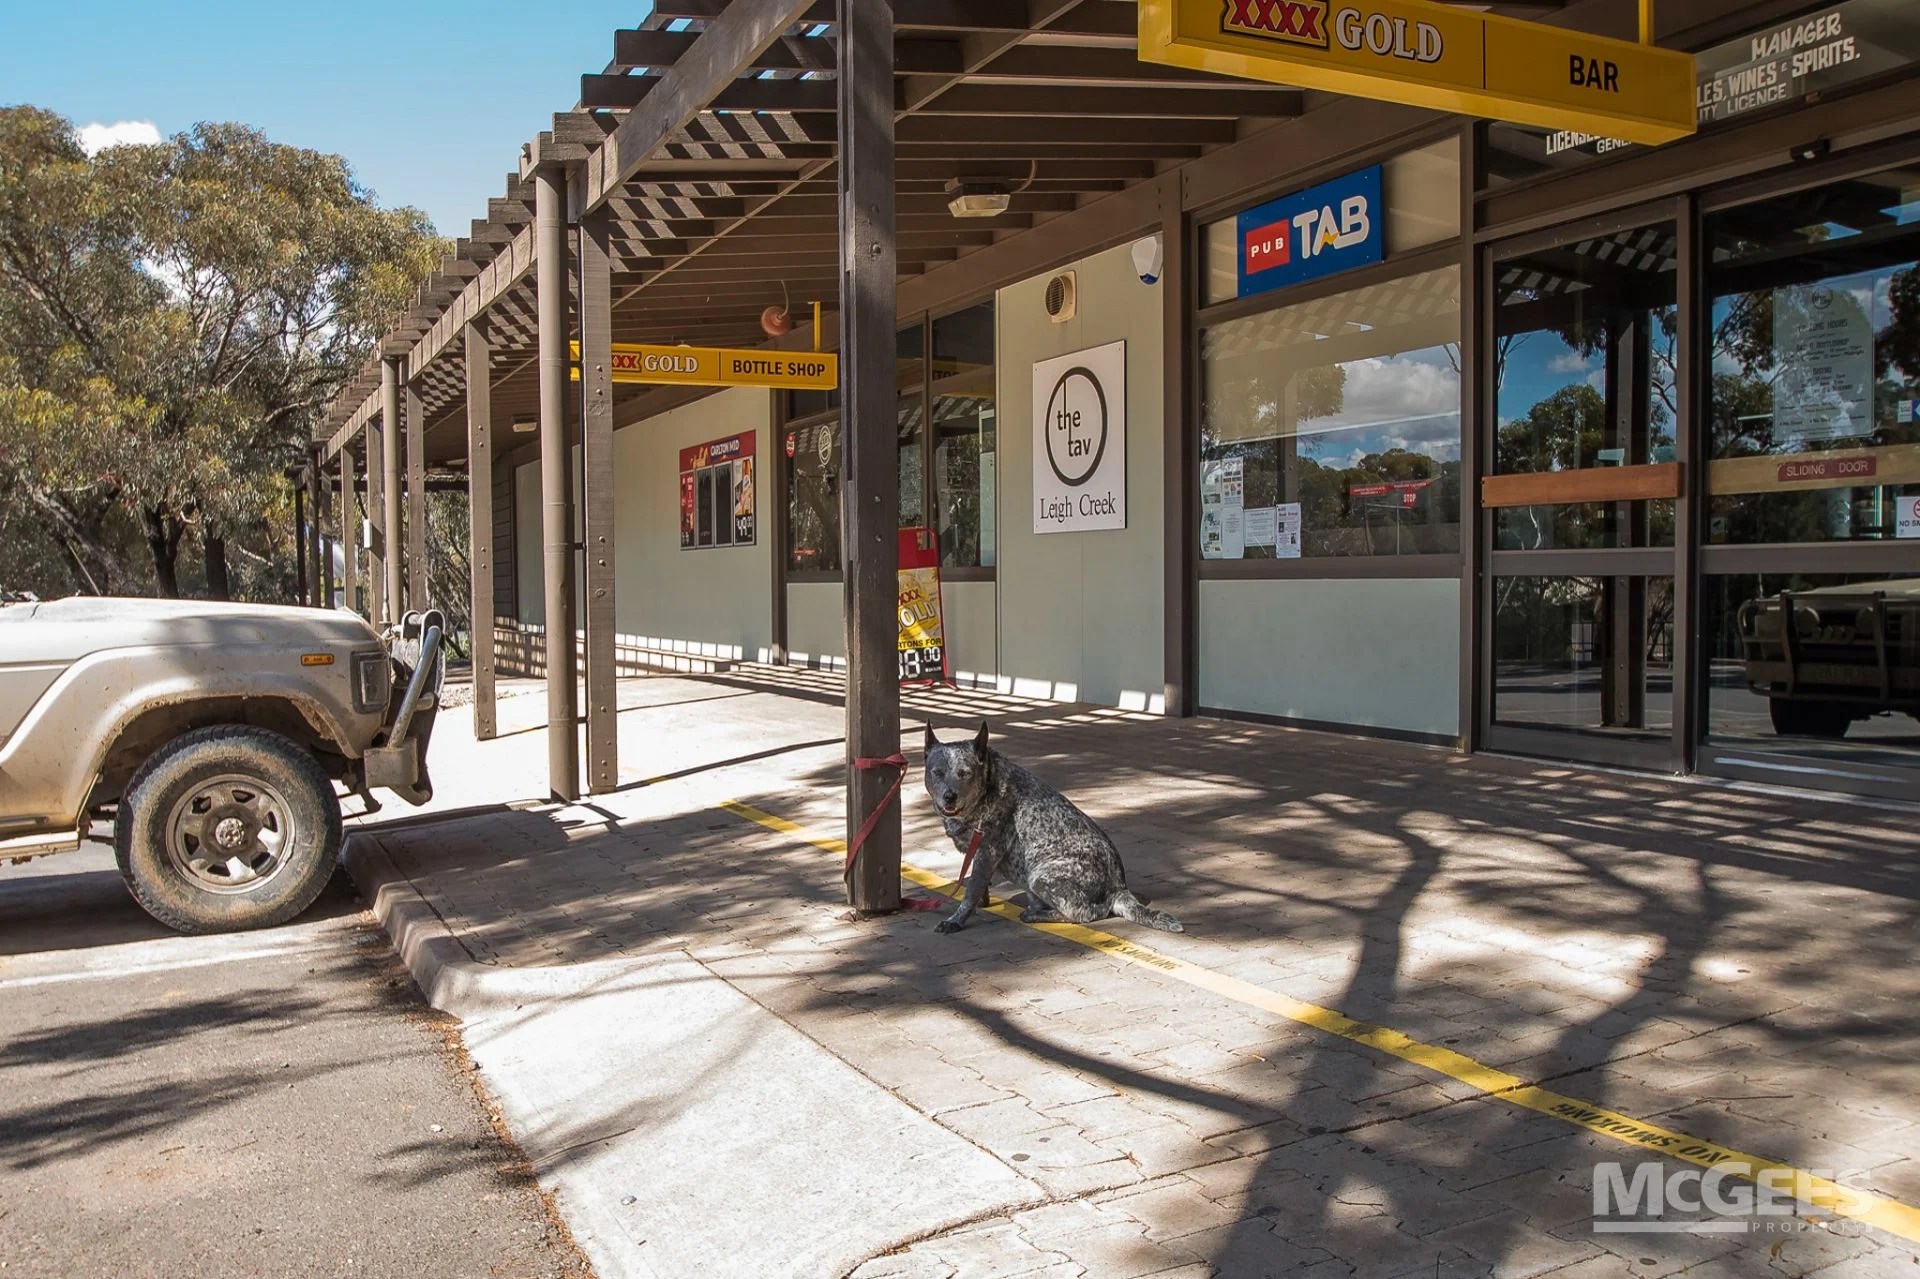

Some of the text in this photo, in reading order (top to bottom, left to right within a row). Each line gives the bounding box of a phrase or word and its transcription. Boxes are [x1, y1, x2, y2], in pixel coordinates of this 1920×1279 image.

[1230, 0, 1443, 63] XXXX GOLD
[1752, 12, 1842, 62] MANAGER
[1568, 54, 1619, 94] BAR
[1696, 79, 1727, 107] LES,
[1727, 61, 1777, 97] WINES
[1791, 36, 1861, 79] SPIRITS.
[1727, 82, 1787, 115] LICENCE
[1250, 195, 1370, 260] PUB TAB
[644, 354, 698, 373] GOLD
[732, 359, 826, 377] BOTTLE SHOP
[710, 442, 729, 456] CARLTON
[1067, 432, 1091, 457] tav
[1786, 460, 1869, 477] SLIDING DOOR
[1040, 492, 1116, 523] Leigh Creek
[899, 601, 935, 633] OLD
[925, 638, 942, 647] FOR
[1550, 1102, 1731, 1163] NO SMOKING
